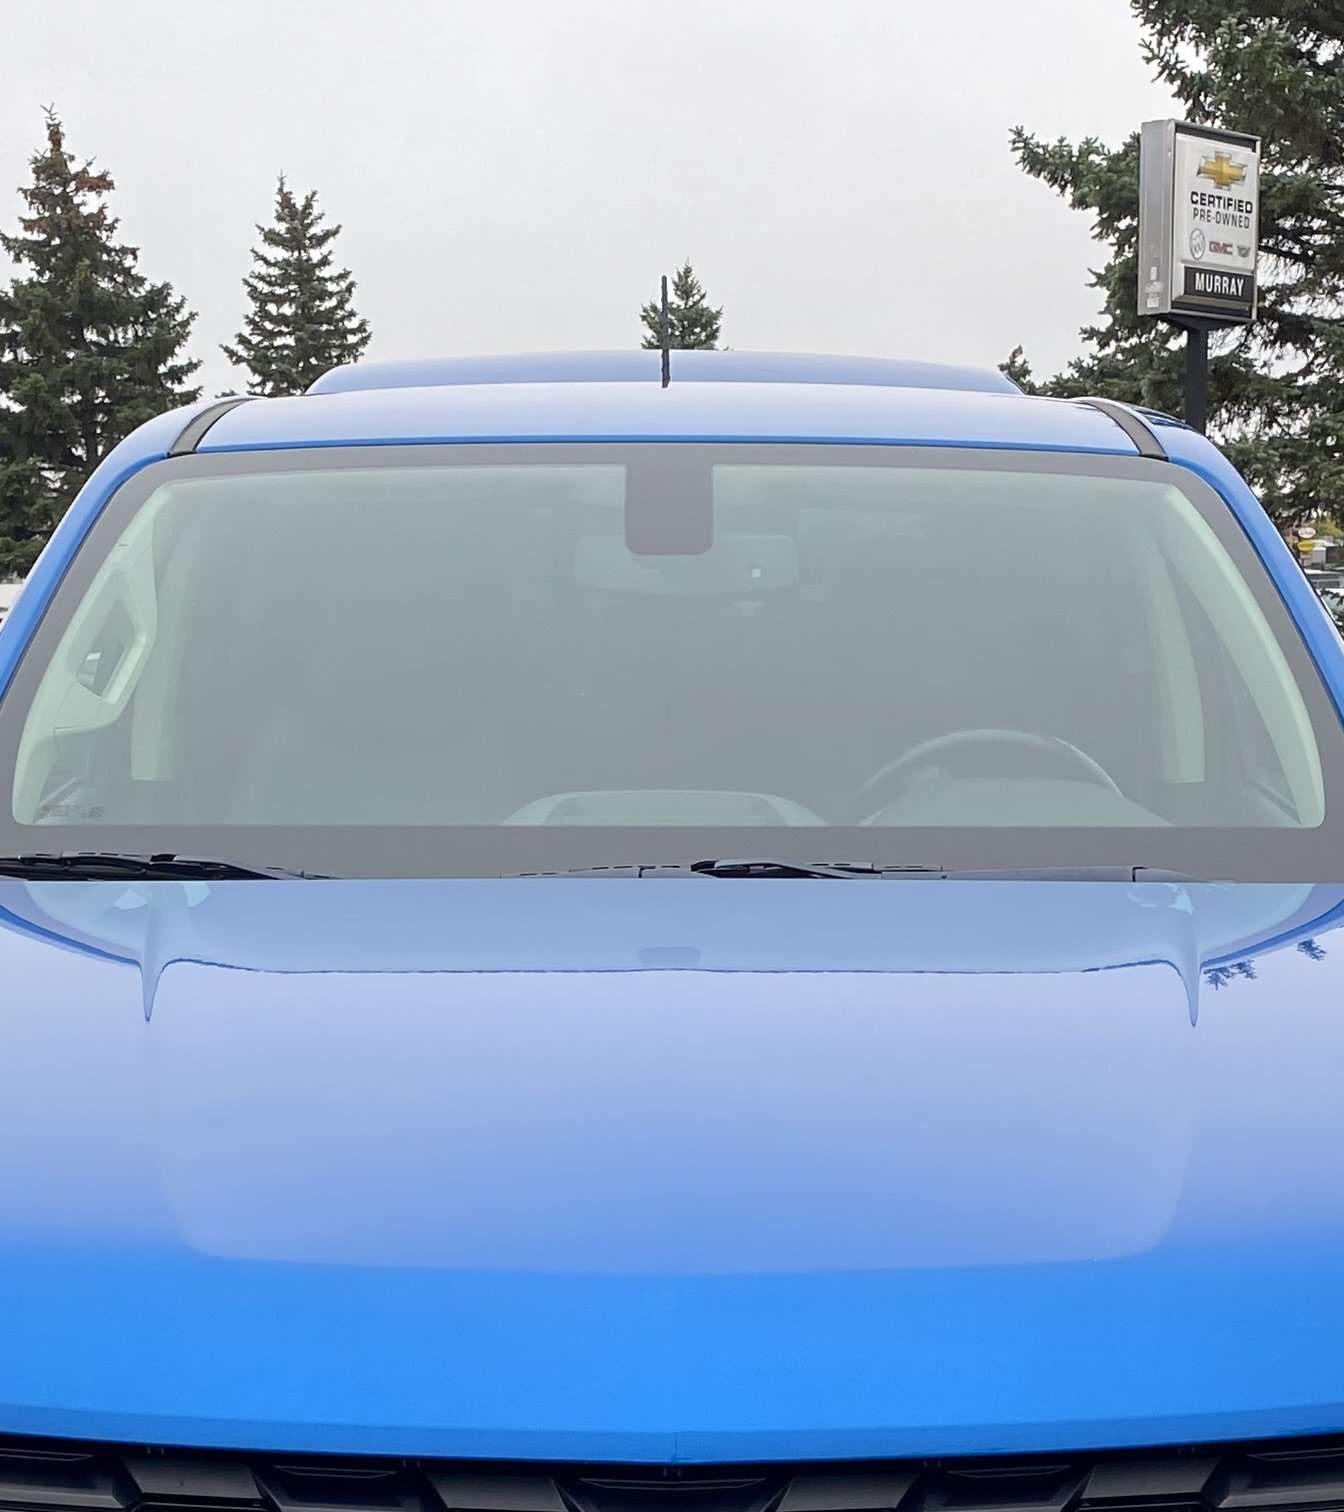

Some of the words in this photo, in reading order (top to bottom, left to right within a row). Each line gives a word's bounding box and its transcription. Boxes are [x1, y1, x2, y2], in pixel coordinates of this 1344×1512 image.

[1191, 191, 1253, 214] CERTIFIED
[1193, 207, 1250, 229] PRE-OWNED
[1209, 241, 1233, 256] GMC
[1195, 272, 1244, 297] MURRAY
